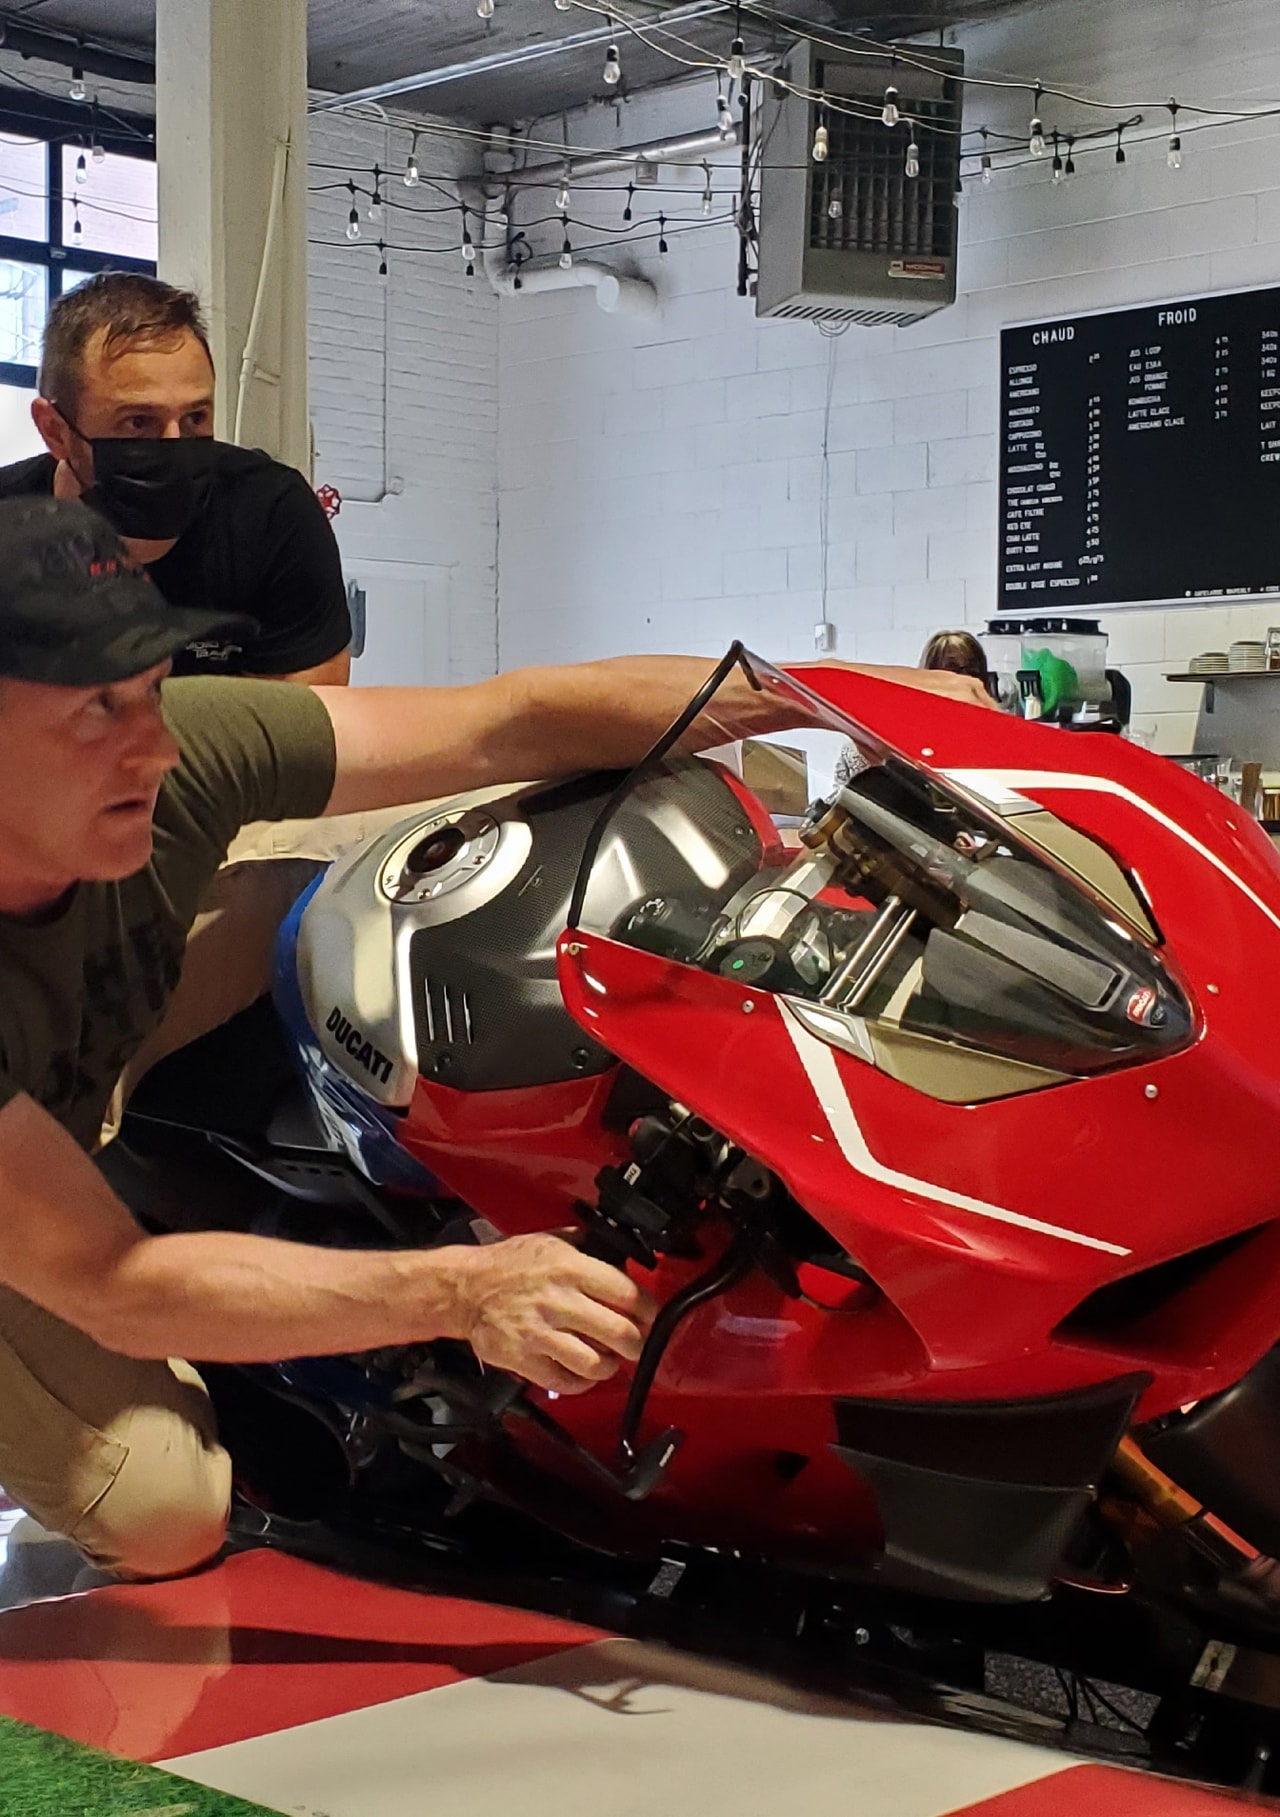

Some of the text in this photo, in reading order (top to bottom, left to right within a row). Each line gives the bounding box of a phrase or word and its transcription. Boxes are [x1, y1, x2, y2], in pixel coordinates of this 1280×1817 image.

[1158, 308, 1197, 327] FROID
[1032, 326, 1075, 346] CHAUD
[1127, 408, 1148, 419] LATTE
[1007, 443, 1028, 453] LATTE
[1261, 453, 1280, 462] CREW
[1022, 532, 1041, 542] LATTE
[325, 1005, 394, 1085] DUCATI
